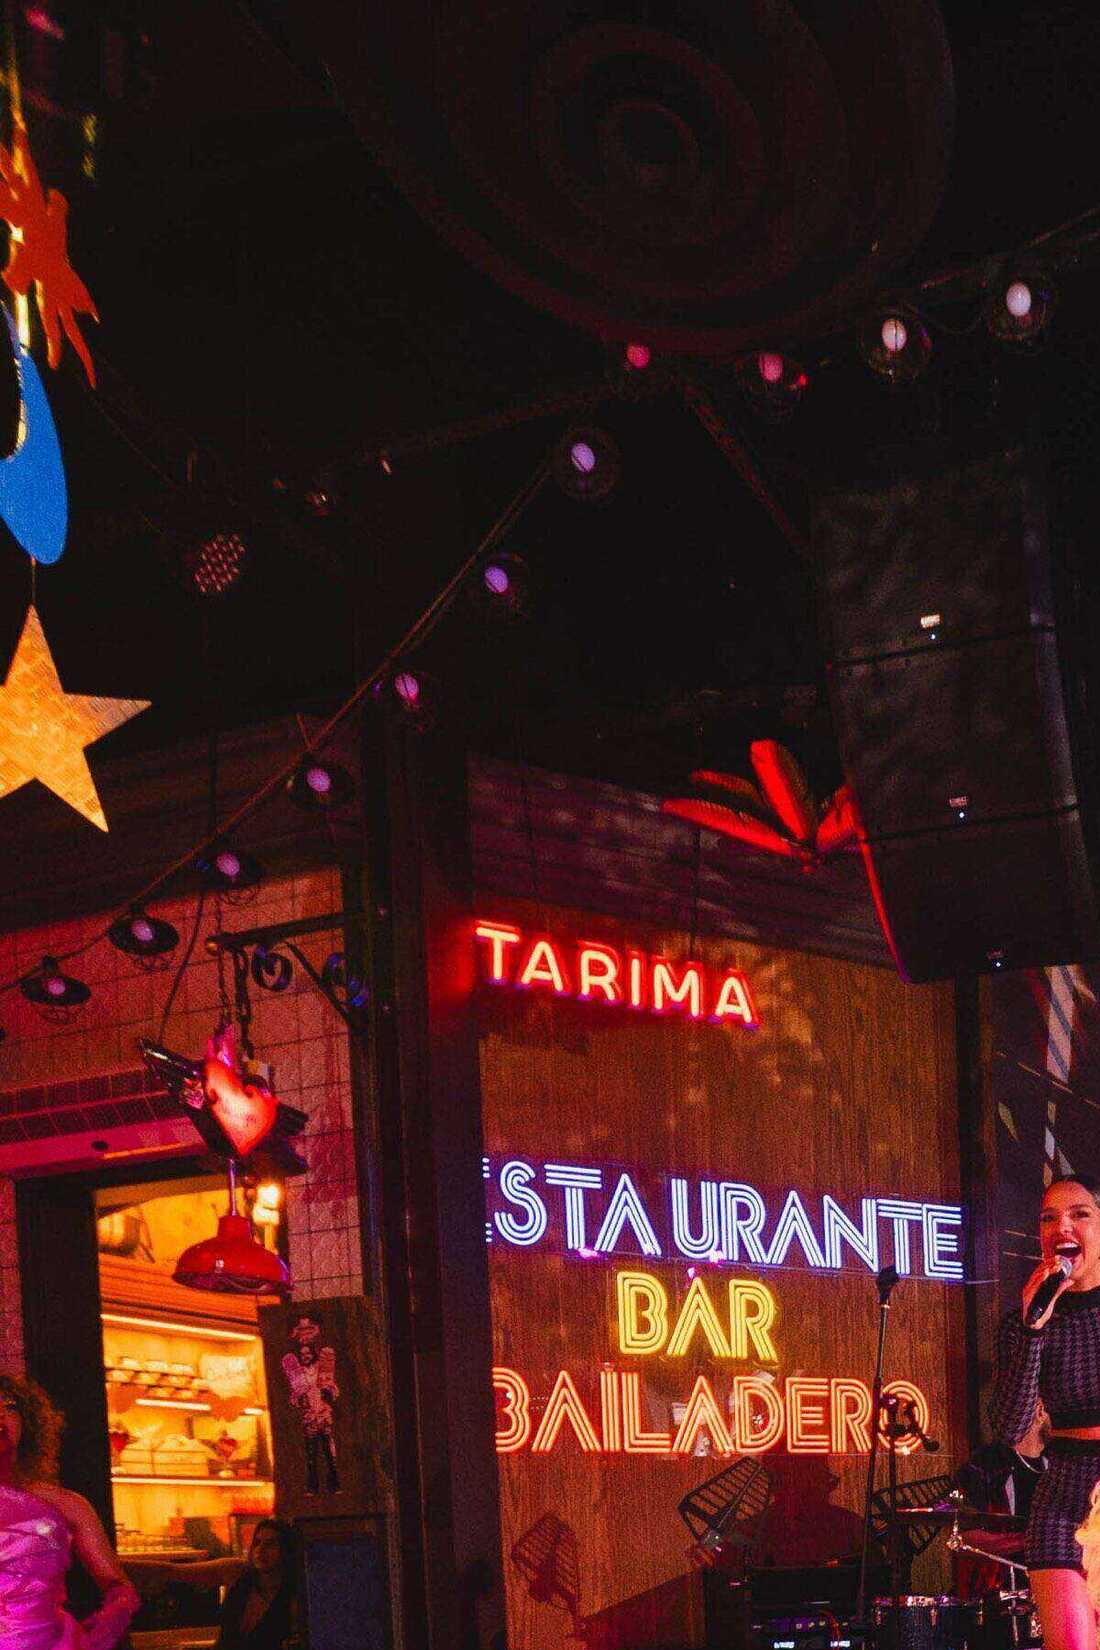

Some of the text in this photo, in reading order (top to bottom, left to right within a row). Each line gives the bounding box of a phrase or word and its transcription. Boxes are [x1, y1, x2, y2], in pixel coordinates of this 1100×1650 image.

[475, 922, 754, 1025] TARIMA
[481, 1156, 964, 1280] STAURANTE
[616, 1270, 778, 1361] BAR
[491, 1366, 930, 1456] BAILADERO
